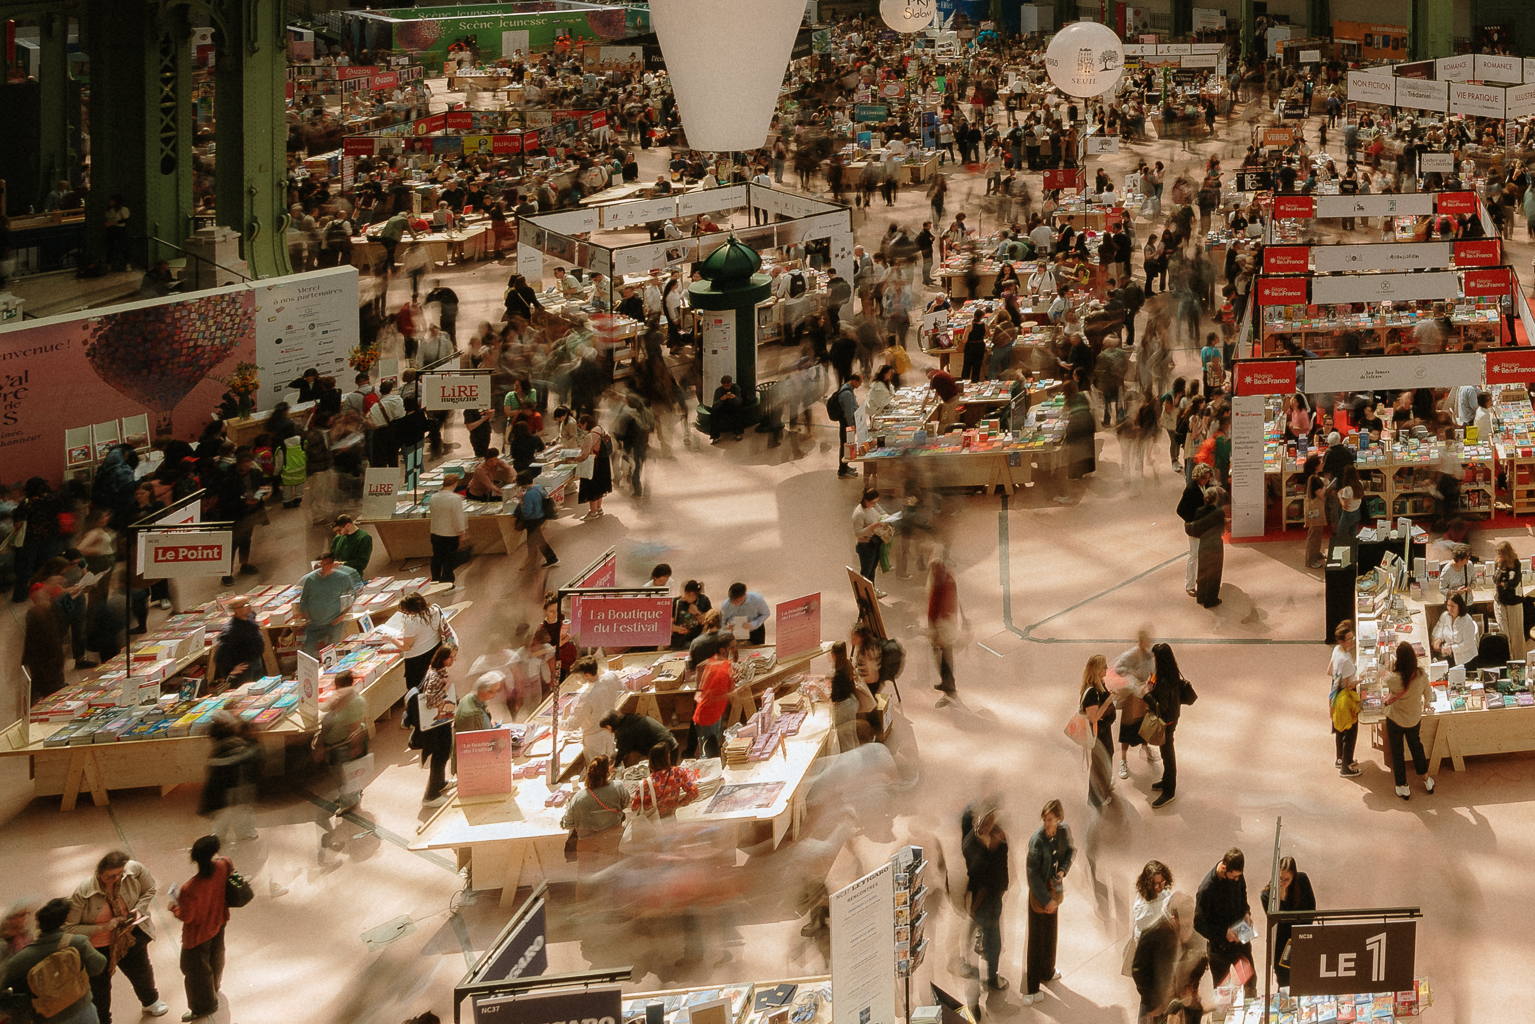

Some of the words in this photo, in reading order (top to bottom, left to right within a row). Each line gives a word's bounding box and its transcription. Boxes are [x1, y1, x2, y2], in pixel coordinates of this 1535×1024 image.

[459, 20, 494, 30] Scène
[499, 17, 548, 28] Jeunesse
[1443, 61, 1467, 70] ROMANCE
[1484, 61, 1513, 70] ROMANCE
[1352, 80, 1367, 88] NON
[1368, 81, 1390, 91] FICTION
[1408, 91, 1431, 99] Trédaniel
[1456, 91, 1465, 99] VIE
[1466, 92, 1498, 103] PRATIQUE
[1267, 133, 1289, 141] VERSO
[297, 287, 343, 302] partenaires
[298, 285, 320, 294] Merci
[441, 396, 479, 404] magazine
[4, 401, 21, 411] de
[157, 548, 176, 561] Le
[178, 547, 220, 560] Point
[590, 610, 604, 620] La
[608, 609, 663, 621] Boutique
[788, 604, 809, 615] Boutique
[788, 611, 806, 620] Festival
[594, 624, 610, 633] du
[613, 622, 658, 632] Festival
[471, 741, 496, 749] Boutique
[851, 880, 861, 891] LE
[860, 868, 889, 886] FIGARO
[847, 882, 878, 903] RENCONTRES
[1320, 952, 1356, 978] LE
[1366, 932, 1386, 982] 1
[482, 1006, 501, 1014] NC37
